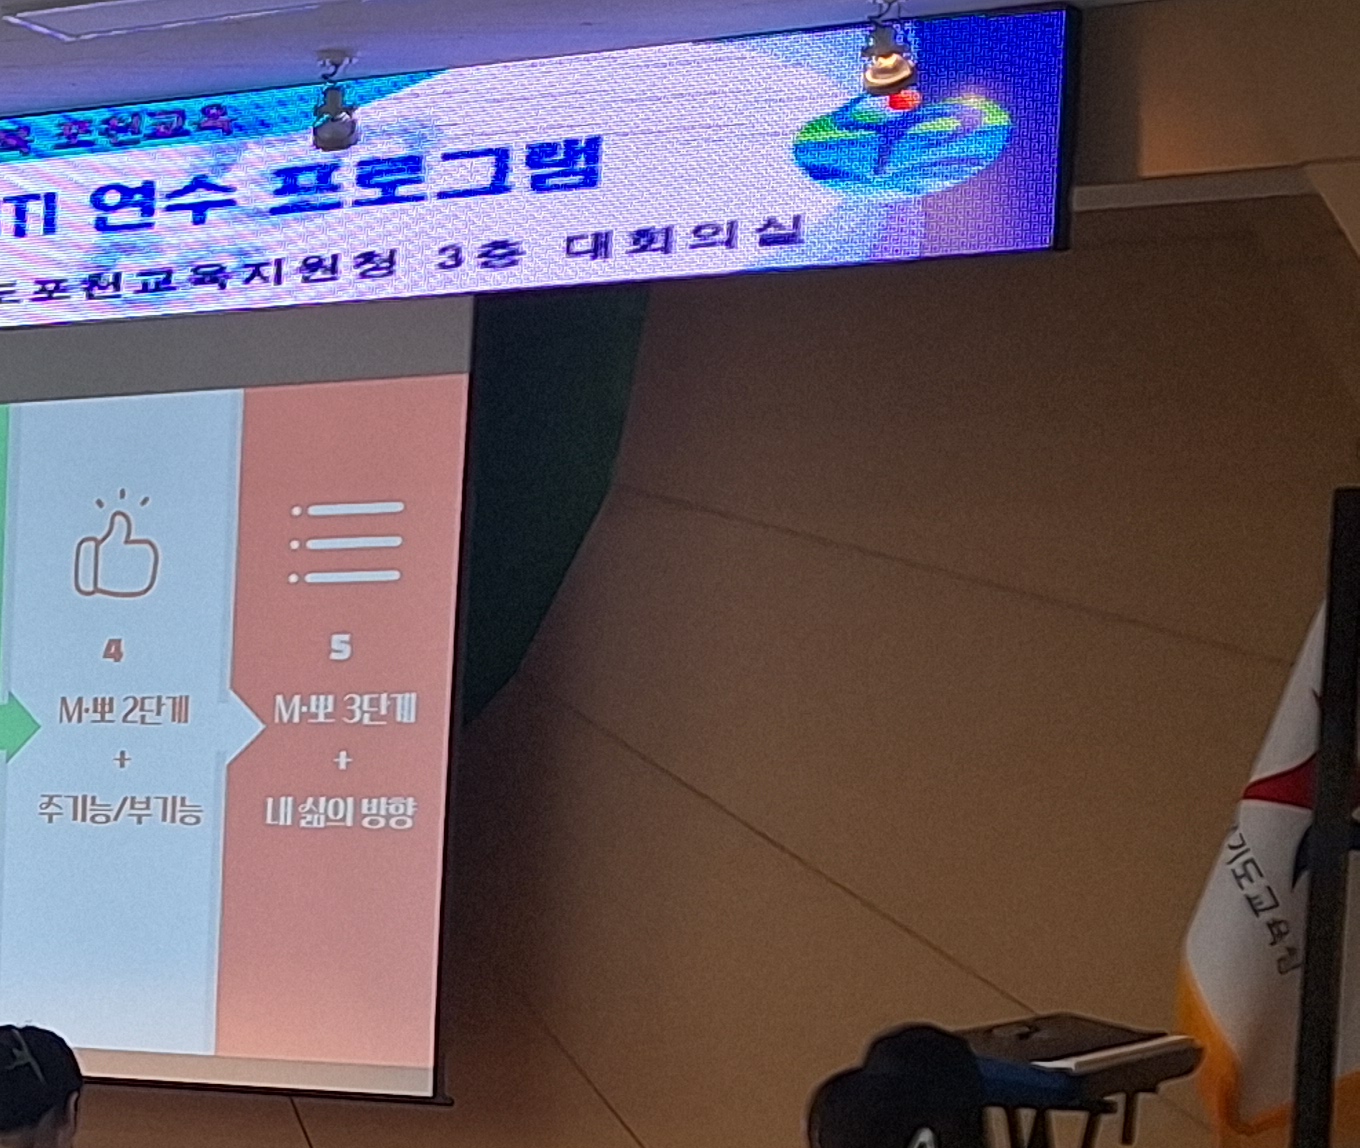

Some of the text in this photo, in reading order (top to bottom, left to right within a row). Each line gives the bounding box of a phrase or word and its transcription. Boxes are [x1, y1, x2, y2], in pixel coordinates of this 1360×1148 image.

[53, 103, 238, 150] 포천교육
[89, 174, 237, 232] 연수
[269, 134, 603, 216] 프로그램
[437, 239, 527, 270] 3층
[566, 214, 805, 261] 대회의실
[102, 637, 124, 663] 4
[329, 633, 353, 661] 5
[121, 693, 190, 726] 2단계
[341, 691, 418, 726] 3단계
[38, 793, 204, 827] 주기능/부기능
[265, 795, 419, 830] 내 삶의 방향
